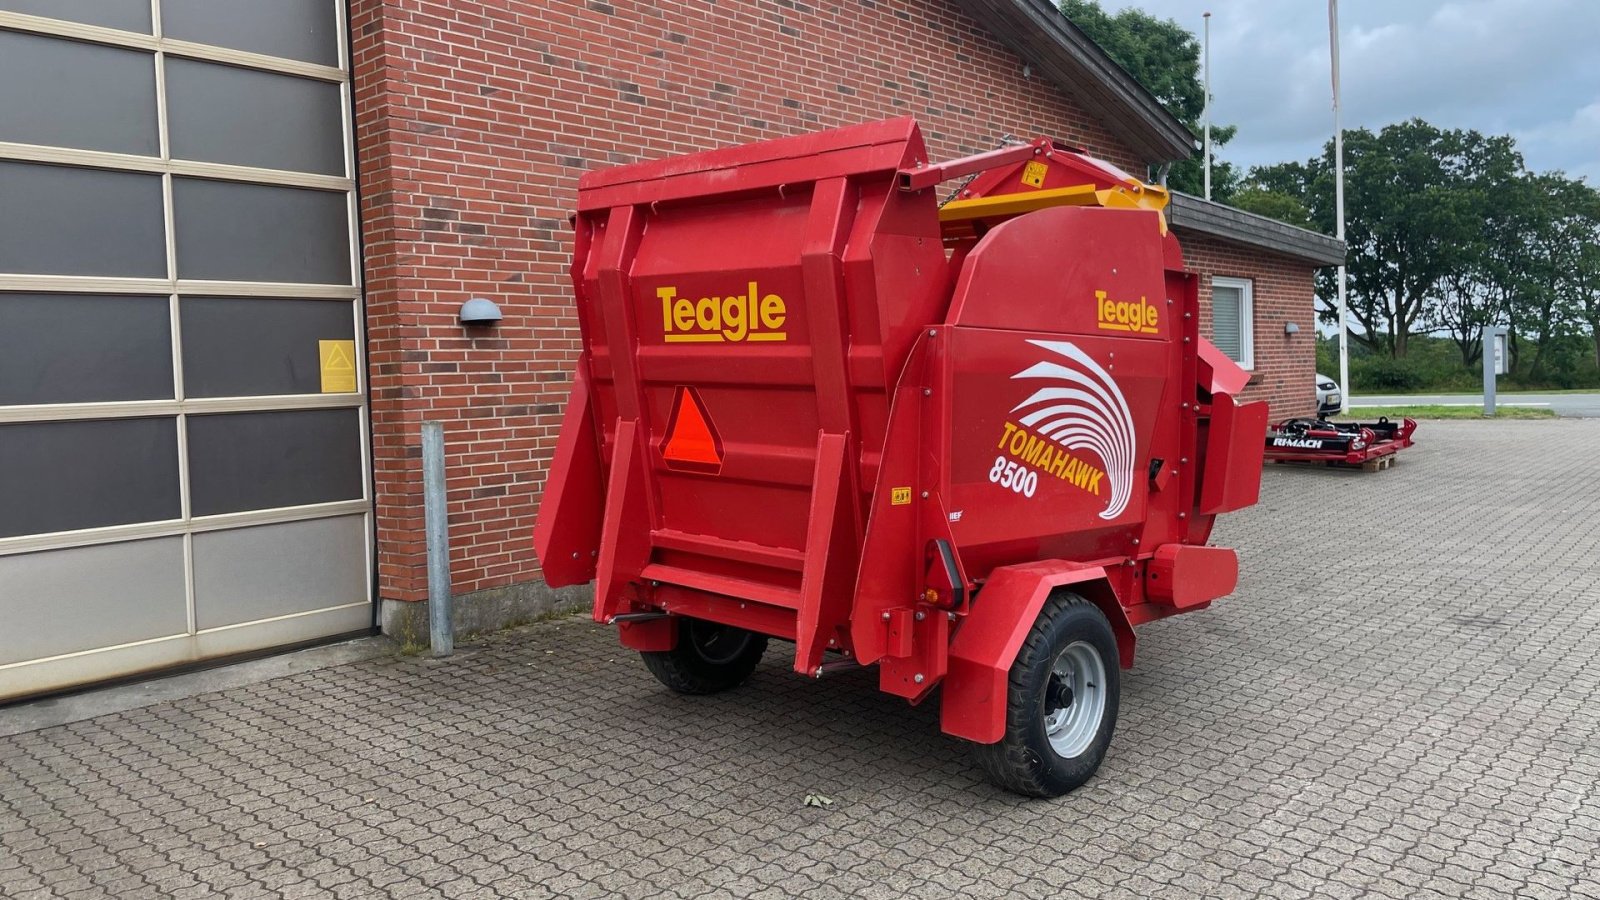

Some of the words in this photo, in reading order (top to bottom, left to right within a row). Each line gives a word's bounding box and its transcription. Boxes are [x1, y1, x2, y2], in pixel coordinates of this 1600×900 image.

[657, 281, 786, 342] Teagle
[1095, 289, 1158, 332] Teagle
[989, 456, 1038, 498] 8500
[998, 421, 1104, 496] TOMAHAWK
